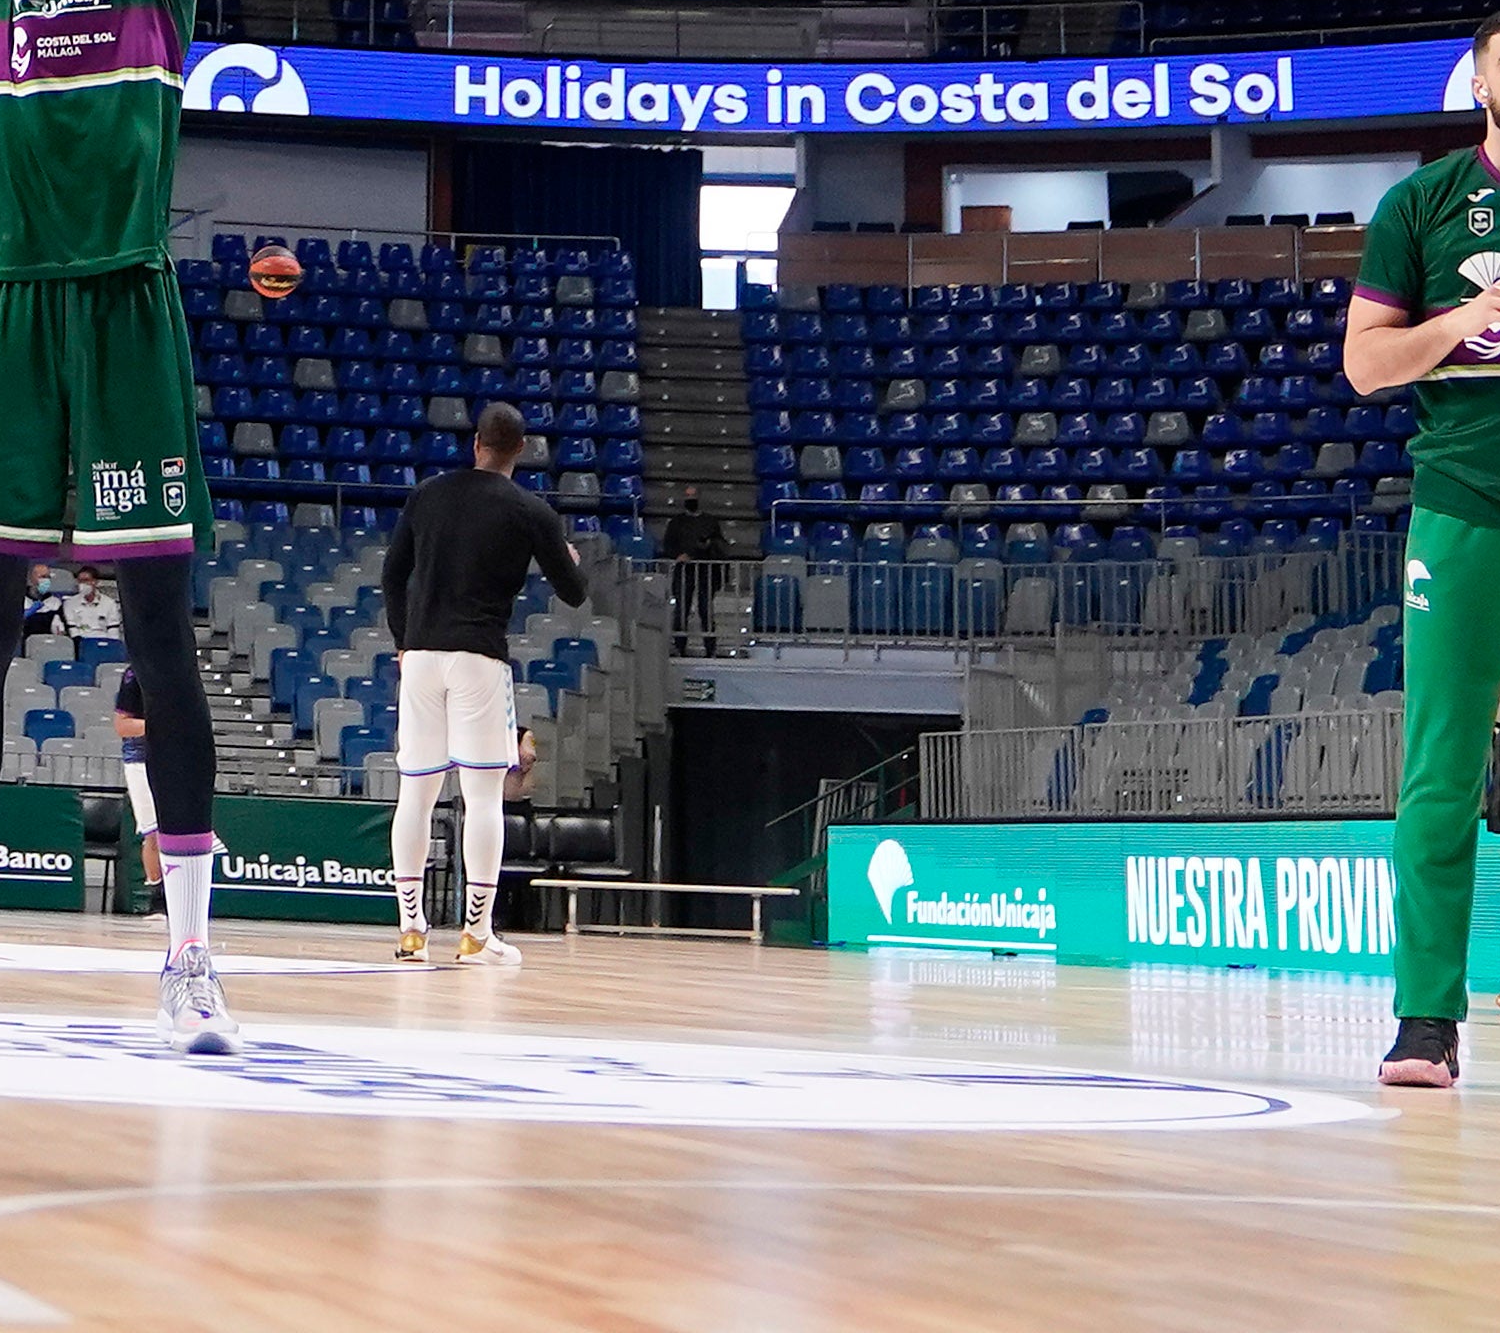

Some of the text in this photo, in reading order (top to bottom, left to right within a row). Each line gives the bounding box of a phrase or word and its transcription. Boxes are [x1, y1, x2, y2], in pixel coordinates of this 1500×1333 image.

[37, 31, 116, 48] COSTA DEL SOL
[453, 56, 1294, 131] Holidays in Costa del Sol
[94, 482, 147, 513] laga
[221, 855, 318, 888] Unicaja
[907, 887, 1057, 940] FundaciónUnicaja
[1126, 855, 1270, 950] NUESTRA
